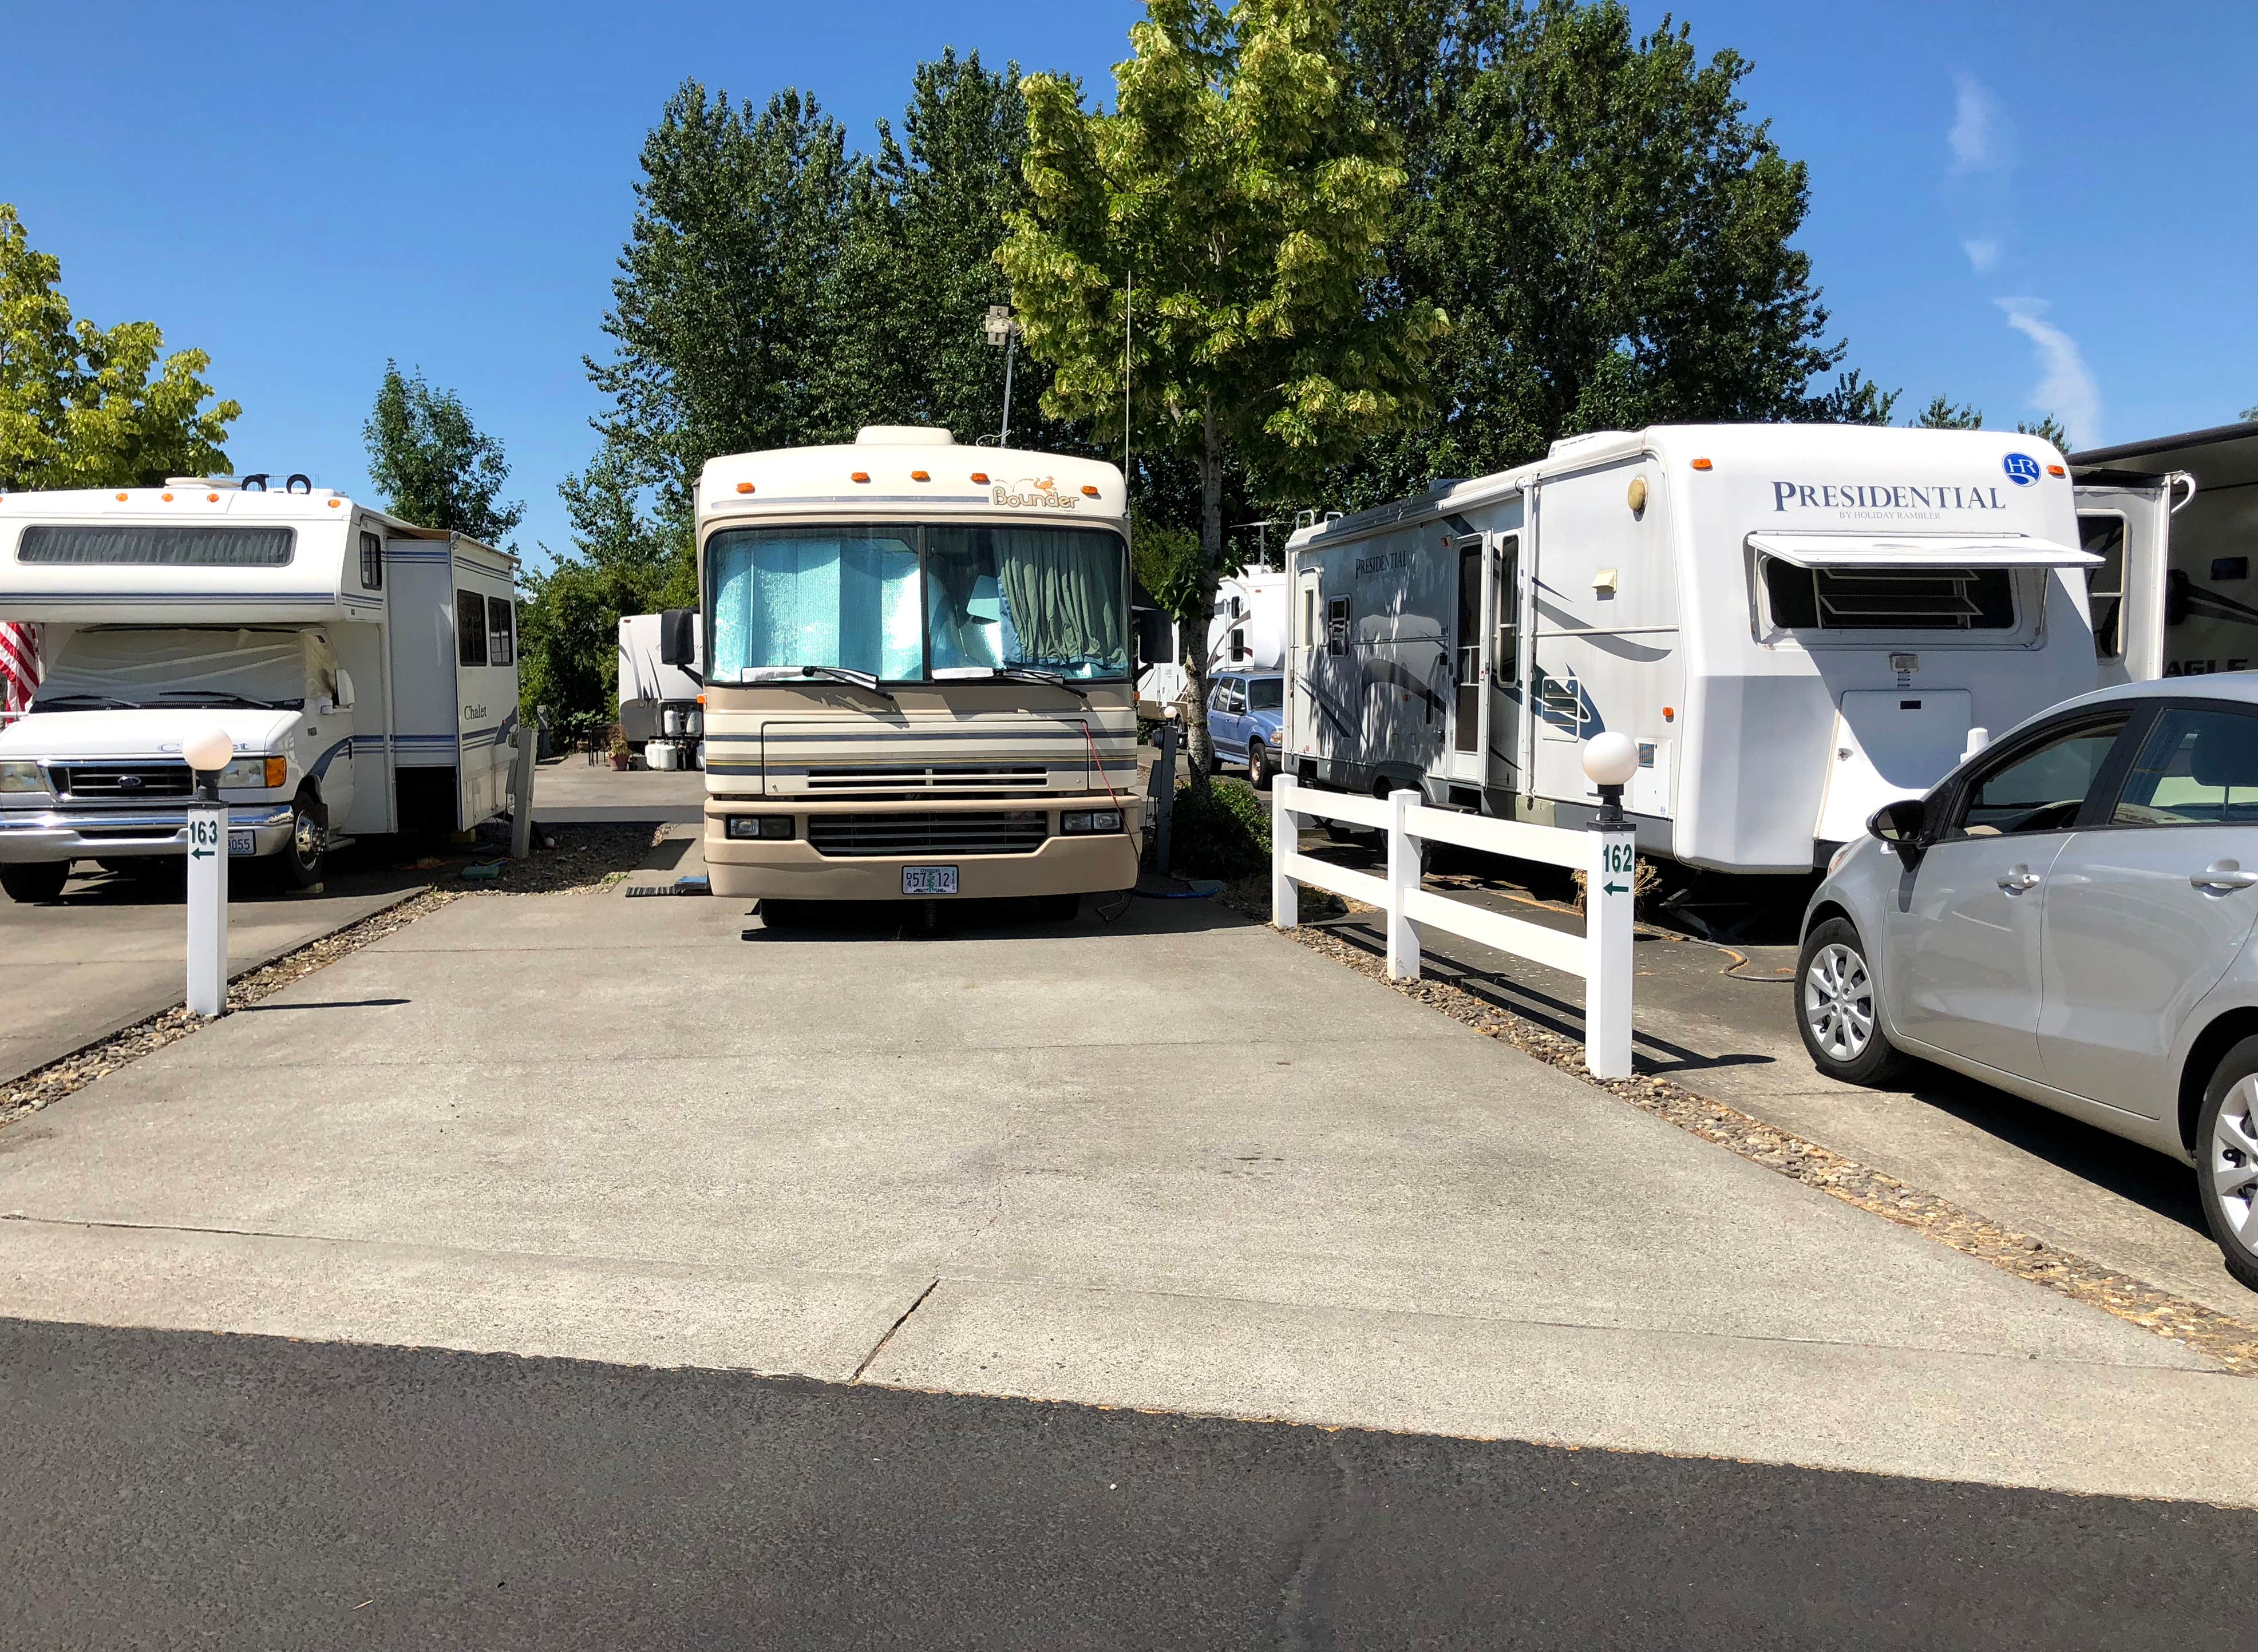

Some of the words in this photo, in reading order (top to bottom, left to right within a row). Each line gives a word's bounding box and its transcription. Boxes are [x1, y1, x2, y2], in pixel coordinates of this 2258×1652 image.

[2007, 458, 2036, 473] HR
[992, 486, 1079, 509] Bounder
[1770, 481, 2006, 512] PRESIDENTIAL
[1355, 550, 1406, 579] PRESIDENTIAL
[2165, 659, 2248, 676] AGLE
[464, 704, 487, 720] Chalet
[190, 820, 218, 845] 163
[1603, 844, 1632, 873] 162
